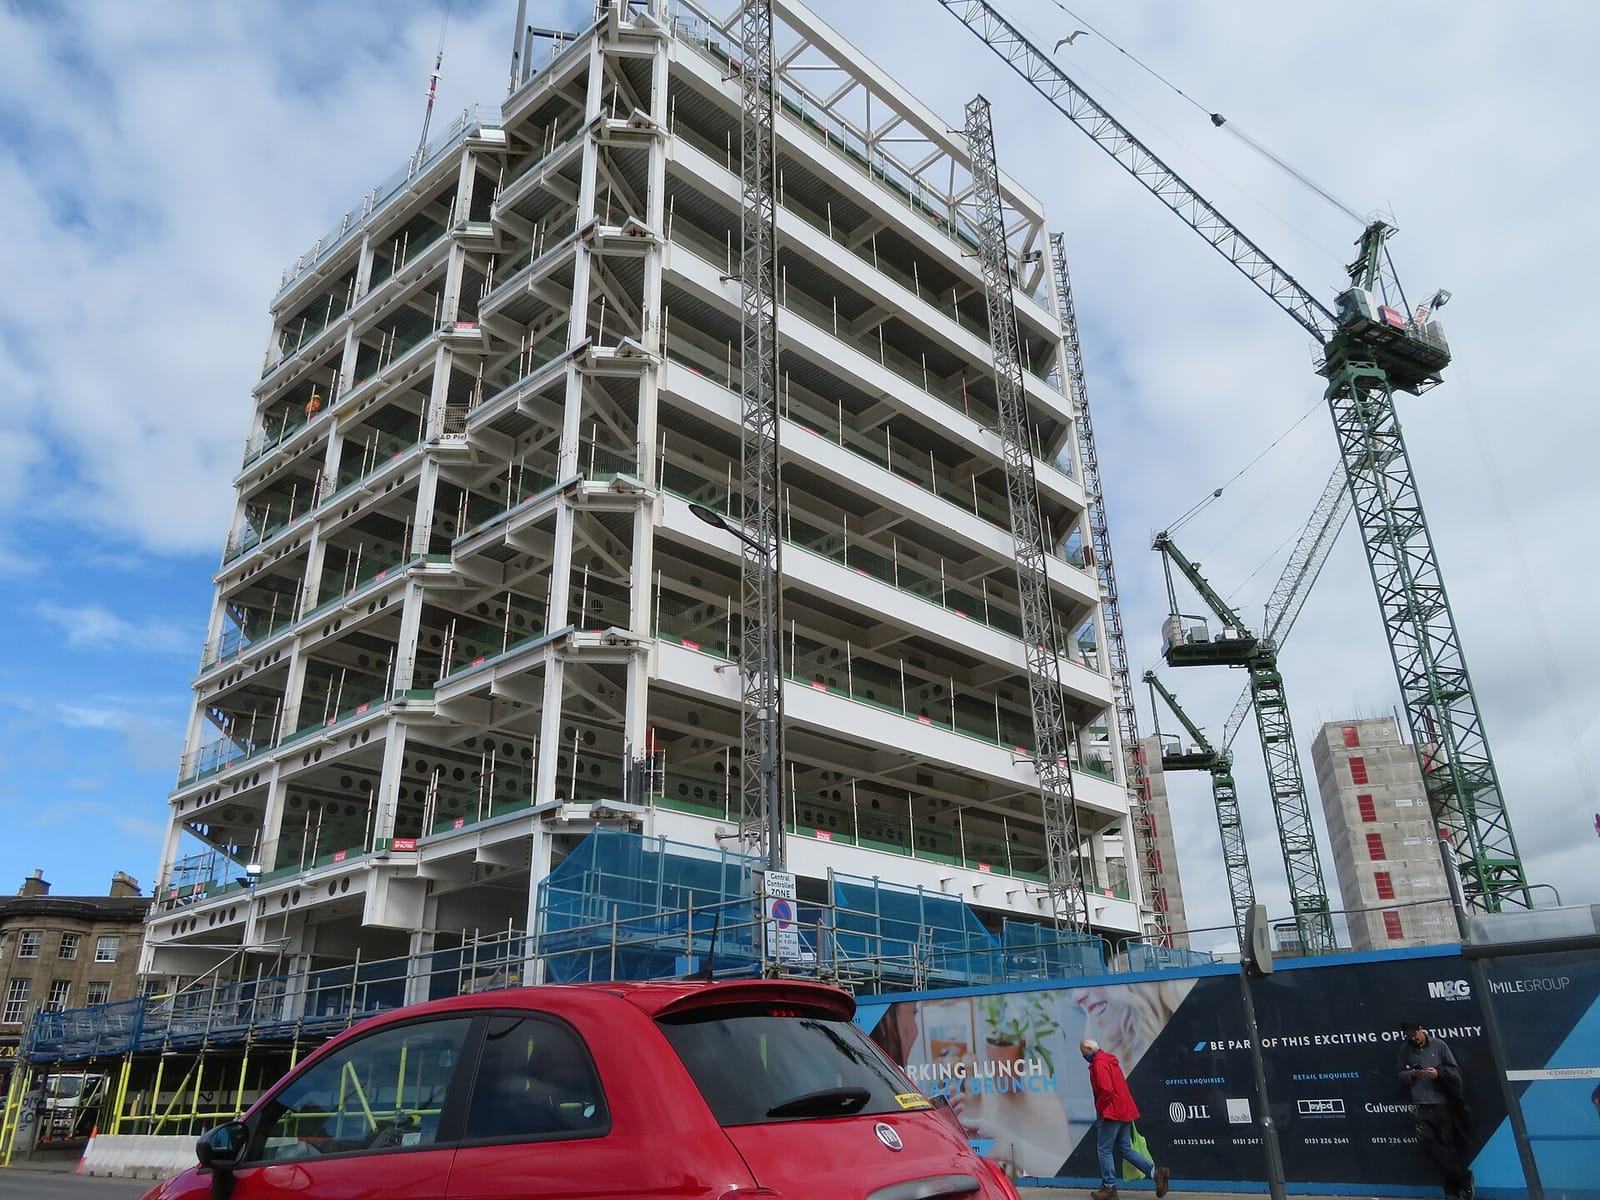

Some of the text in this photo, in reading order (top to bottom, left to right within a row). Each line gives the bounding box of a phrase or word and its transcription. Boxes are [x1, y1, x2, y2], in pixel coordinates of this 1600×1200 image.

[770, 873, 790, 881] Central
[767, 880, 795, 889] Controlled
[771, 889, 791, 898] ZONE
[1427, 979, 1471, 998] M&G
[1210, 1026, 1482, 1051] BE PAR OF THIS EXCITING OPTUNITY
[899, 1058, 1043, 1081] RKING LUNCH
[1190, 1077, 1225, 1085] ENQUIRIES
[1293, 1072, 1360, 1081] RETAIL ENQUIRIES
[970, 1075, 1057, 1095] BRUNCH
[1187, 1105, 1211, 1119] JLL
[1364, 1102, 1417, 1113] Culverwe
[1304, 1137, 1319, 1145] 0131
